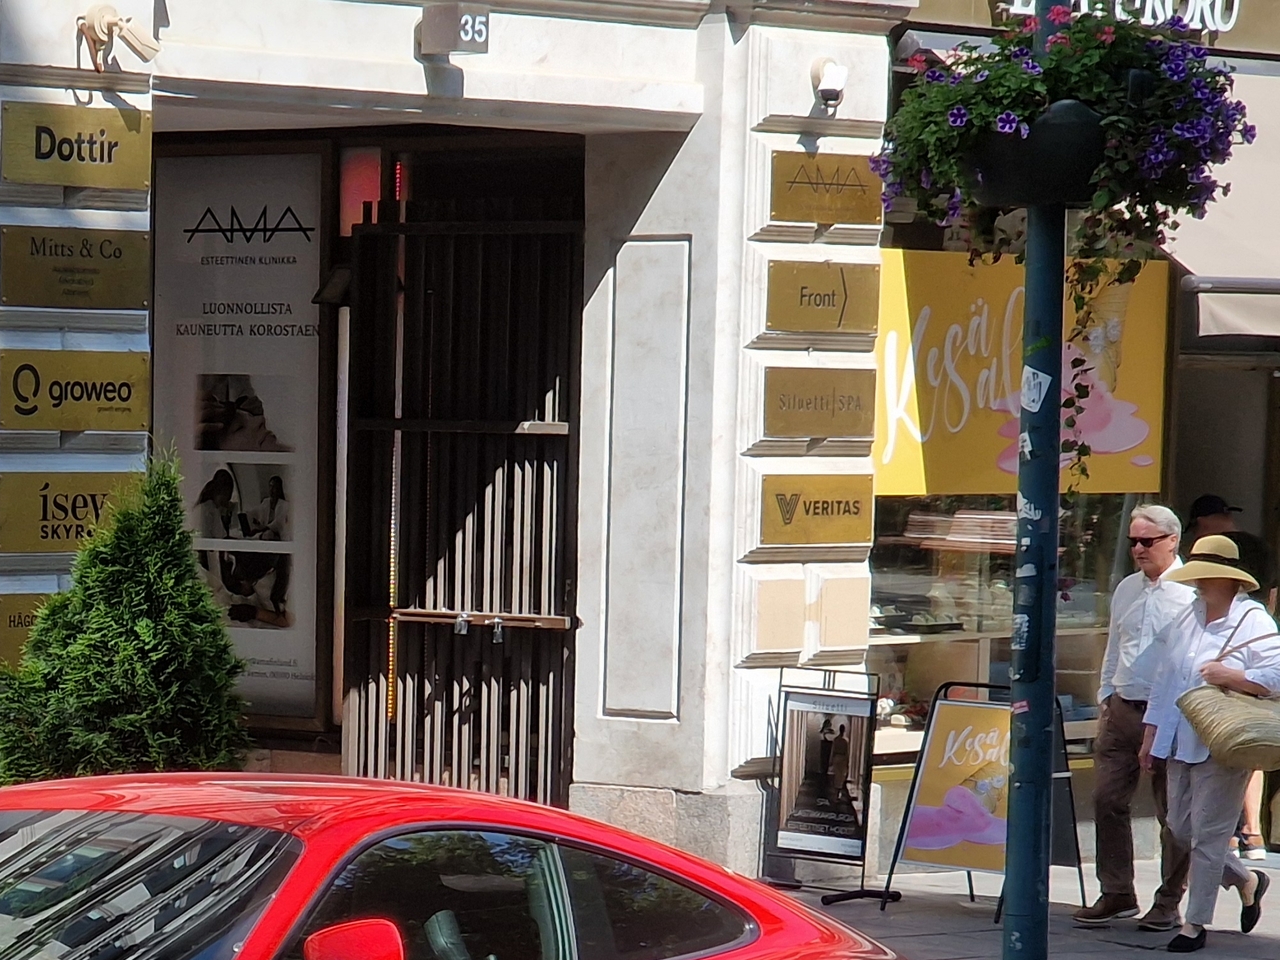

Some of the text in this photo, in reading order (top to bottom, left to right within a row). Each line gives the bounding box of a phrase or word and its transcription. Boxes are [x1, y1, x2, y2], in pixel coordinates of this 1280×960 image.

[460, 14, 487, 43] 35
[34, 125, 119, 164] Dottir
[786, 164, 869, 195] AMA
[183, 204, 316, 244] AMA
[30, 236, 123, 260] Mitts & Co
[200, 256, 256, 266] ESTEETTINEN
[202, 302, 293, 315] LUONNOLLISTA
[799, 286, 837, 308] Front
[175, 323, 244, 337] KAUNEUTTA
[48, 380, 132, 409] groweo
[803, 500, 861, 517] VERITAS
